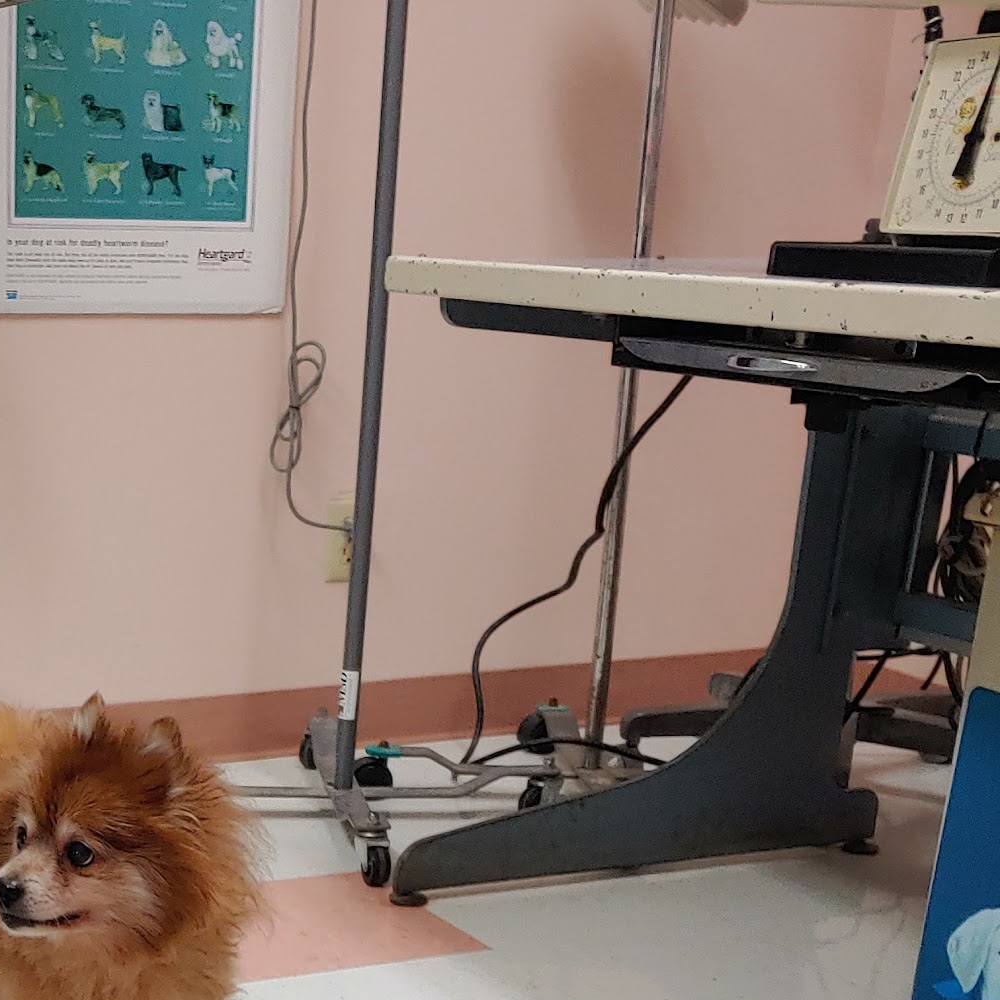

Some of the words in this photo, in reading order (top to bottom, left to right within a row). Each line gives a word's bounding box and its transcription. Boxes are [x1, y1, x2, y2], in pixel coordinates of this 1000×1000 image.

[981, 51, 990, 62] 24
[967, 58, 976, 70] 23
[953, 71, 962, 82] 22
[939, 89, 948, 100] 21
[929, 108, 938, 119] 20
[916, 168, 924, 179] 17
[919, 184, 927, 196] 16
[934, 208, 943, 219] 14
[960, 213, 969, 224] 12
[976, 208, 984, 220] 11
[15, 239, 28, 247] your
[32, 239, 44, 248] dog
[54, 239, 67, 247] risk
[69, 239, 79, 247] for
[80, 239, 101, 248] deadly
[103, 239, 139, 247] heartworm
[198, 248, 245, 263] Heartgard
